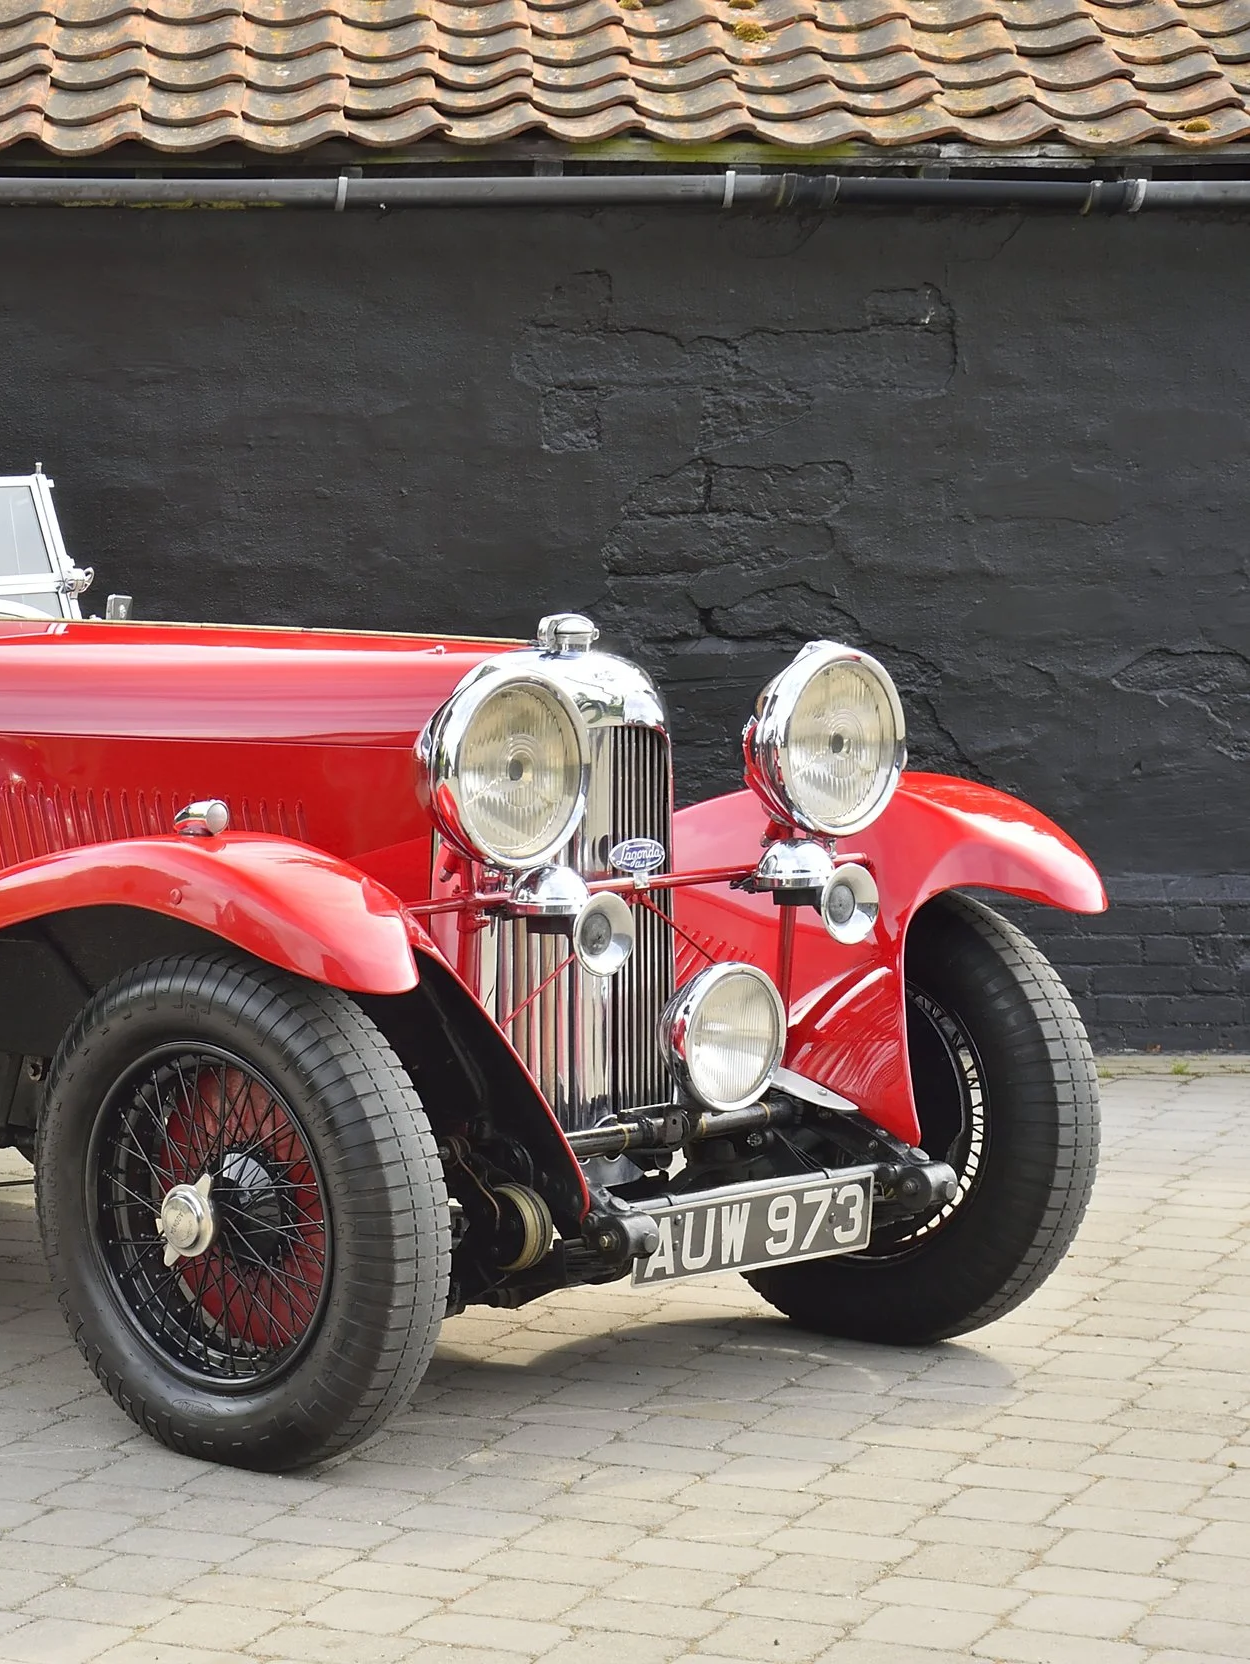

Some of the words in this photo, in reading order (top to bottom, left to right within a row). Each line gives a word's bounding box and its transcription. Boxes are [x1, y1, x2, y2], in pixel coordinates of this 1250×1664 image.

[616, 843, 661, 867] Lagonda
[644, 1202, 751, 1278] AUW
[765, 1184, 865, 1256] 973
